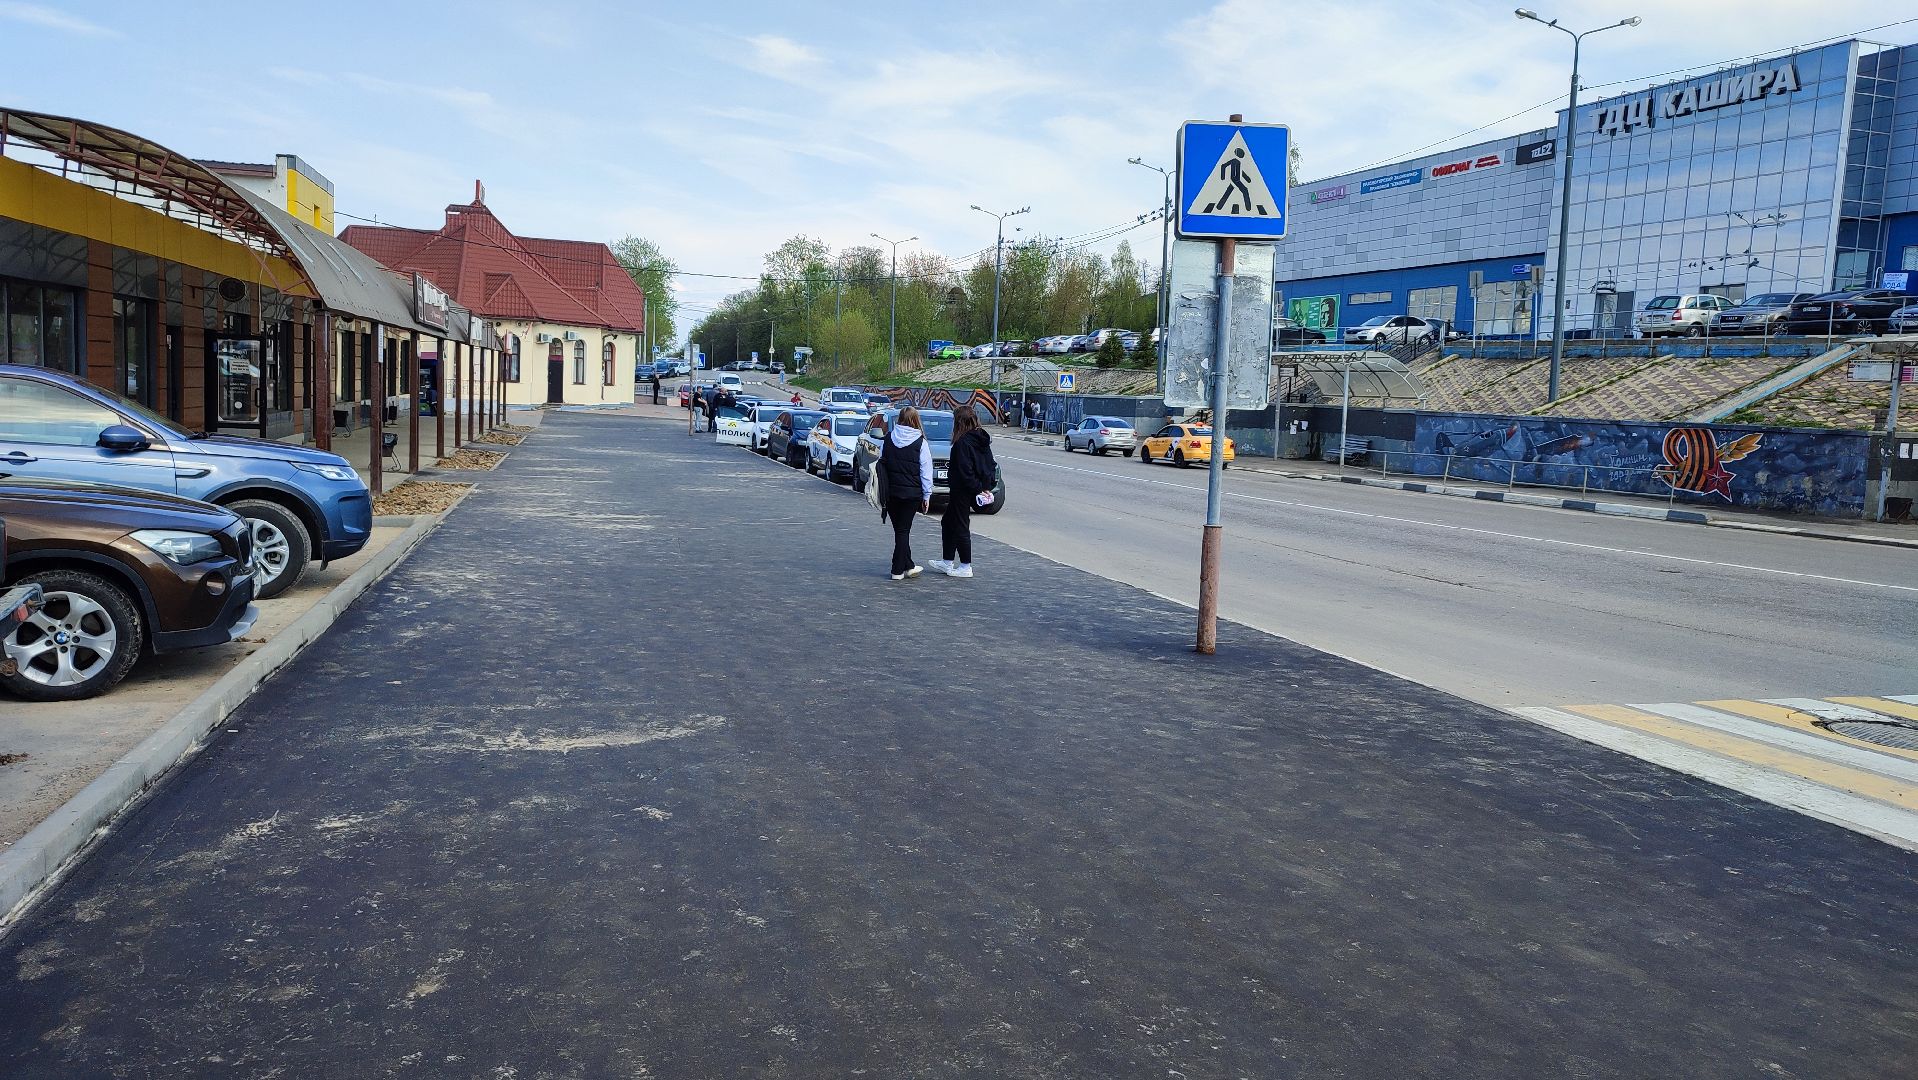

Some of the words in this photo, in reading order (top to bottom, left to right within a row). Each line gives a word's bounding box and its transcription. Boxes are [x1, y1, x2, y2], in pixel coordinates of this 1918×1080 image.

[1588, 97, 1653, 136] ТДЦ
[1658, 63, 1801, 119] КАШИРА
[1531, 143, 1553, 158] TELE2
